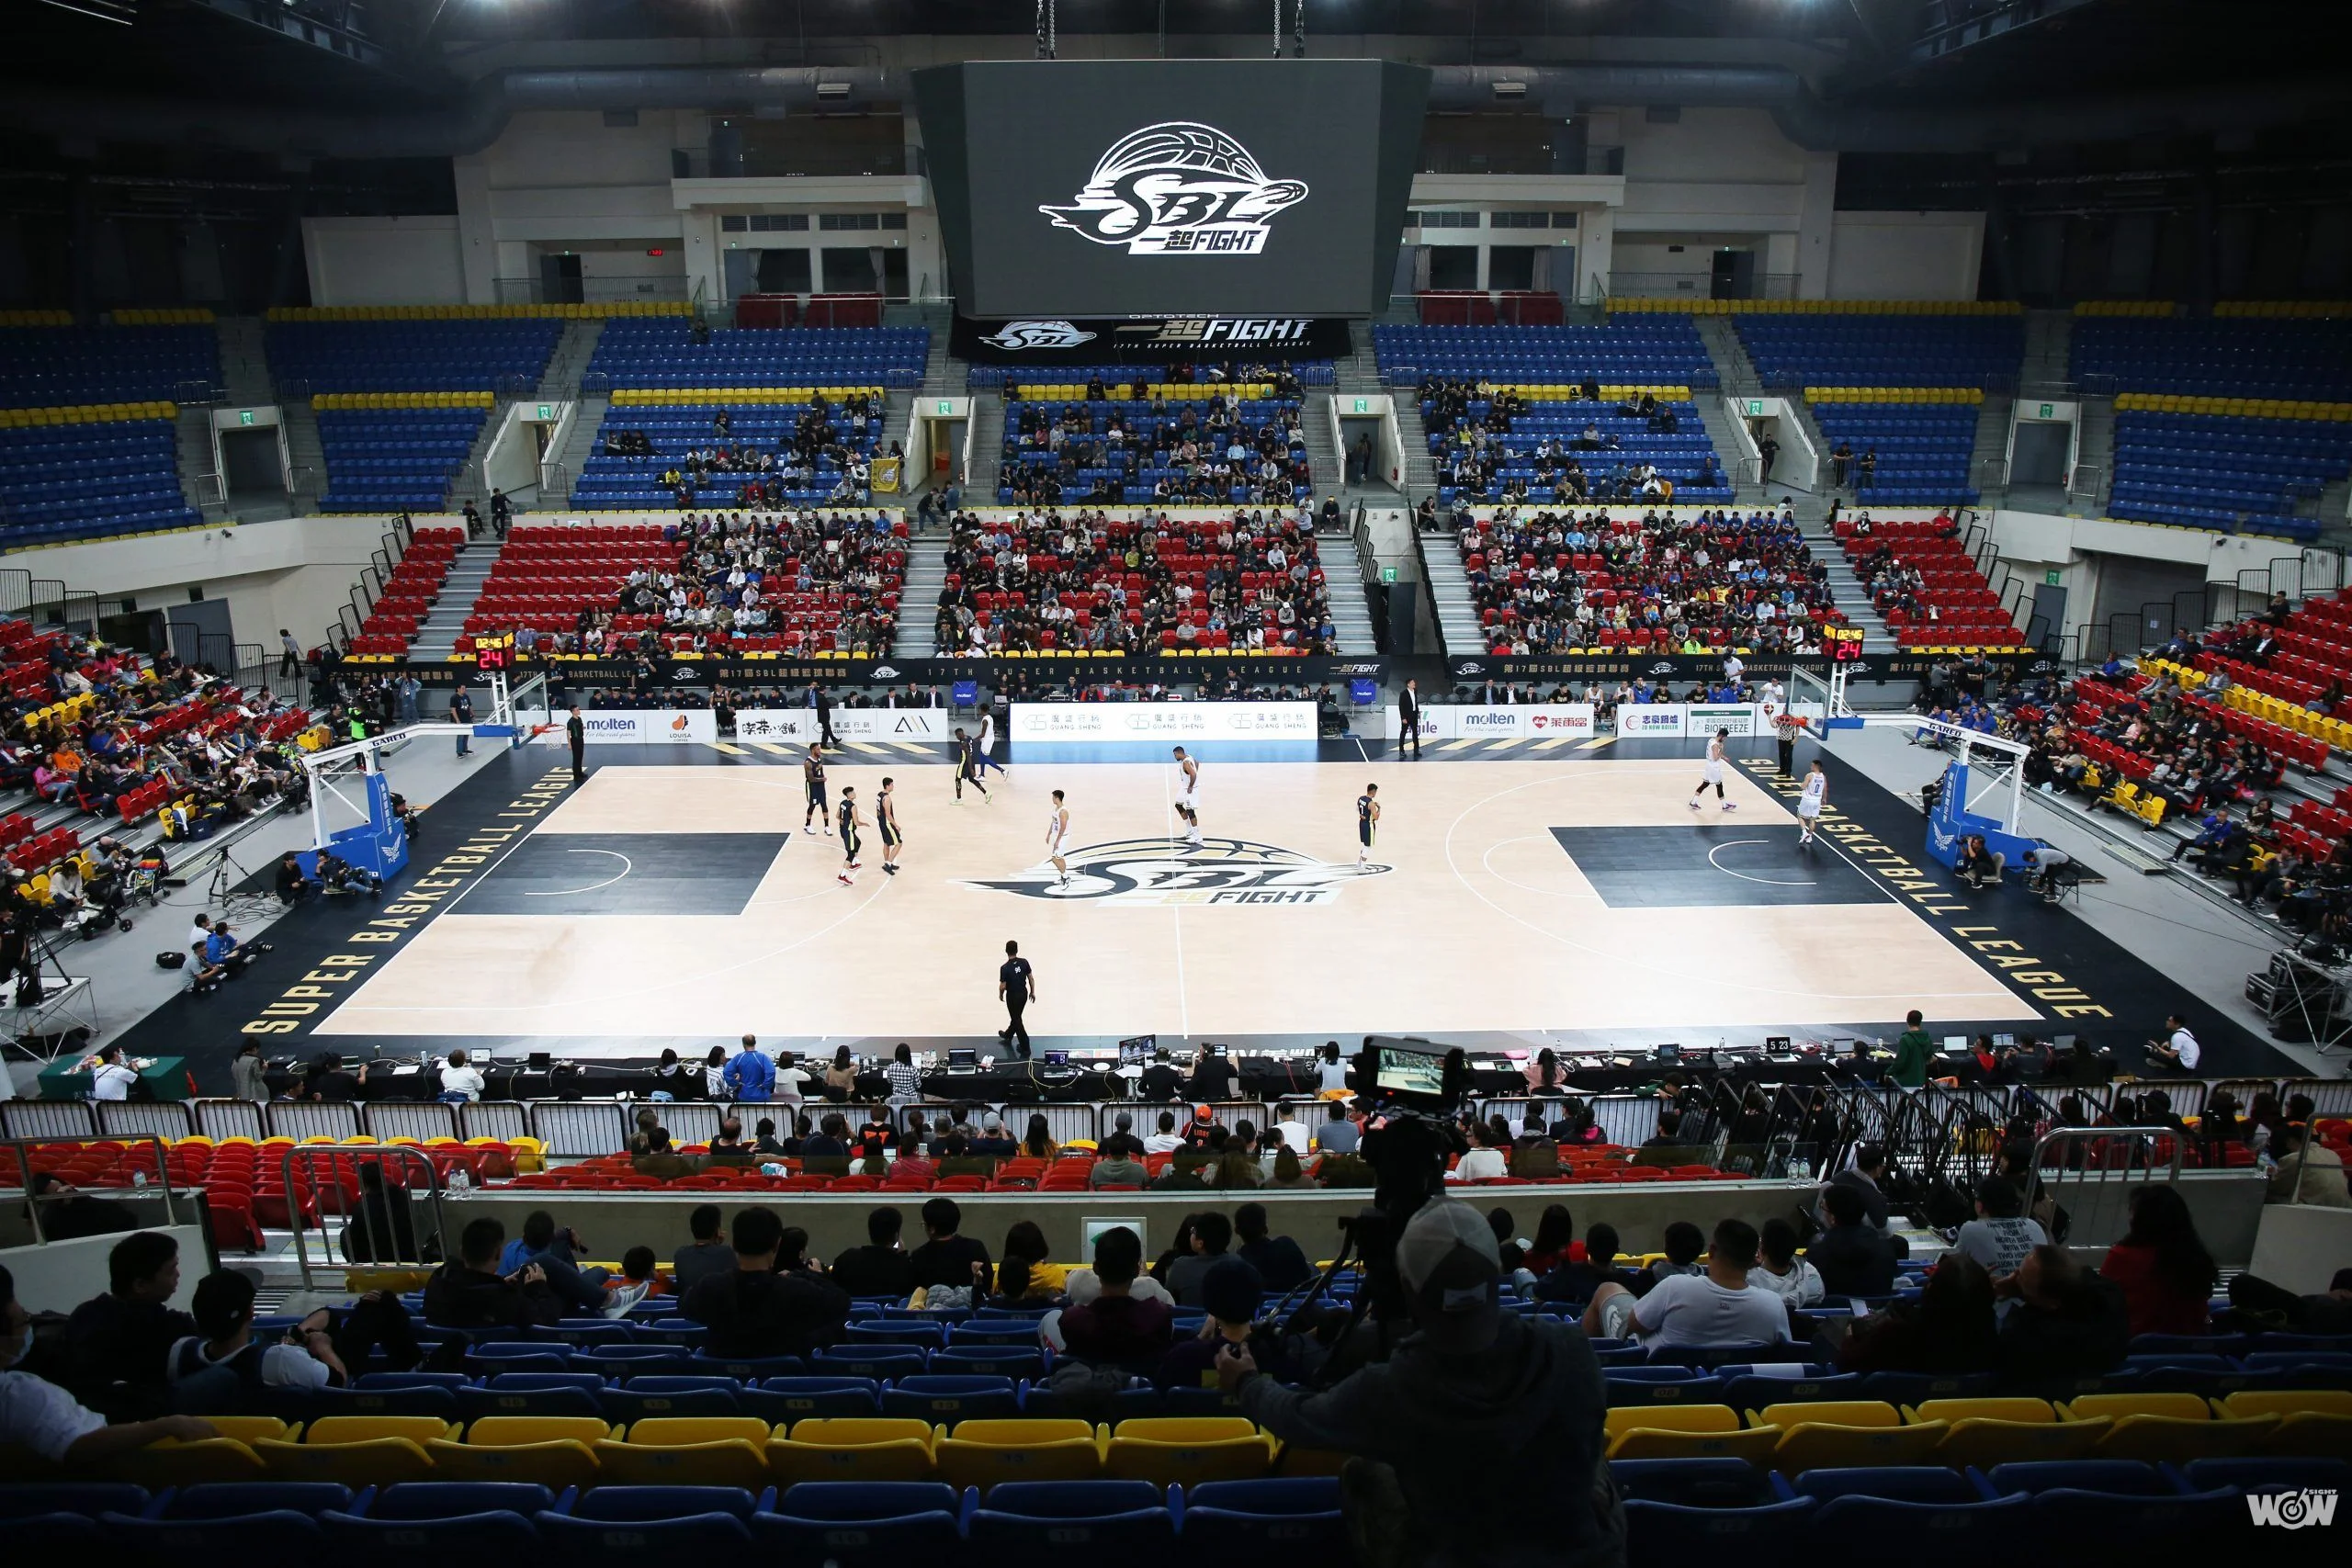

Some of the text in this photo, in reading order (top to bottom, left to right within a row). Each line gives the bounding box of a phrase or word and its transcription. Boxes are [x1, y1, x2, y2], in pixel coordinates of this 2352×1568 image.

[1052, 169, 1275, 241] SBL
[1837, 628, 1863, 640] 02:46
[476, 637, 503, 649] 02:46
[1837, 641, 1860, 660] 24
[480, 650, 503, 668] 24
[928, 668, 973, 676] 17TH
[586, 717, 636, 730] molten
[1466, 713, 1514, 725] molten
[1928, 722, 1962, 738] GARED
[372, 733, 406, 747] GARED
[1814, 784, 1820, 794] 0
[965, 858, 1323, 899] SBL
[241, 766, 588, 1034] SUPER BASKETBALL LEAGUE
[1951, 926, 2114, 1019] LEAGUE
[1770, 1040, 1789, 1050] 5 23
